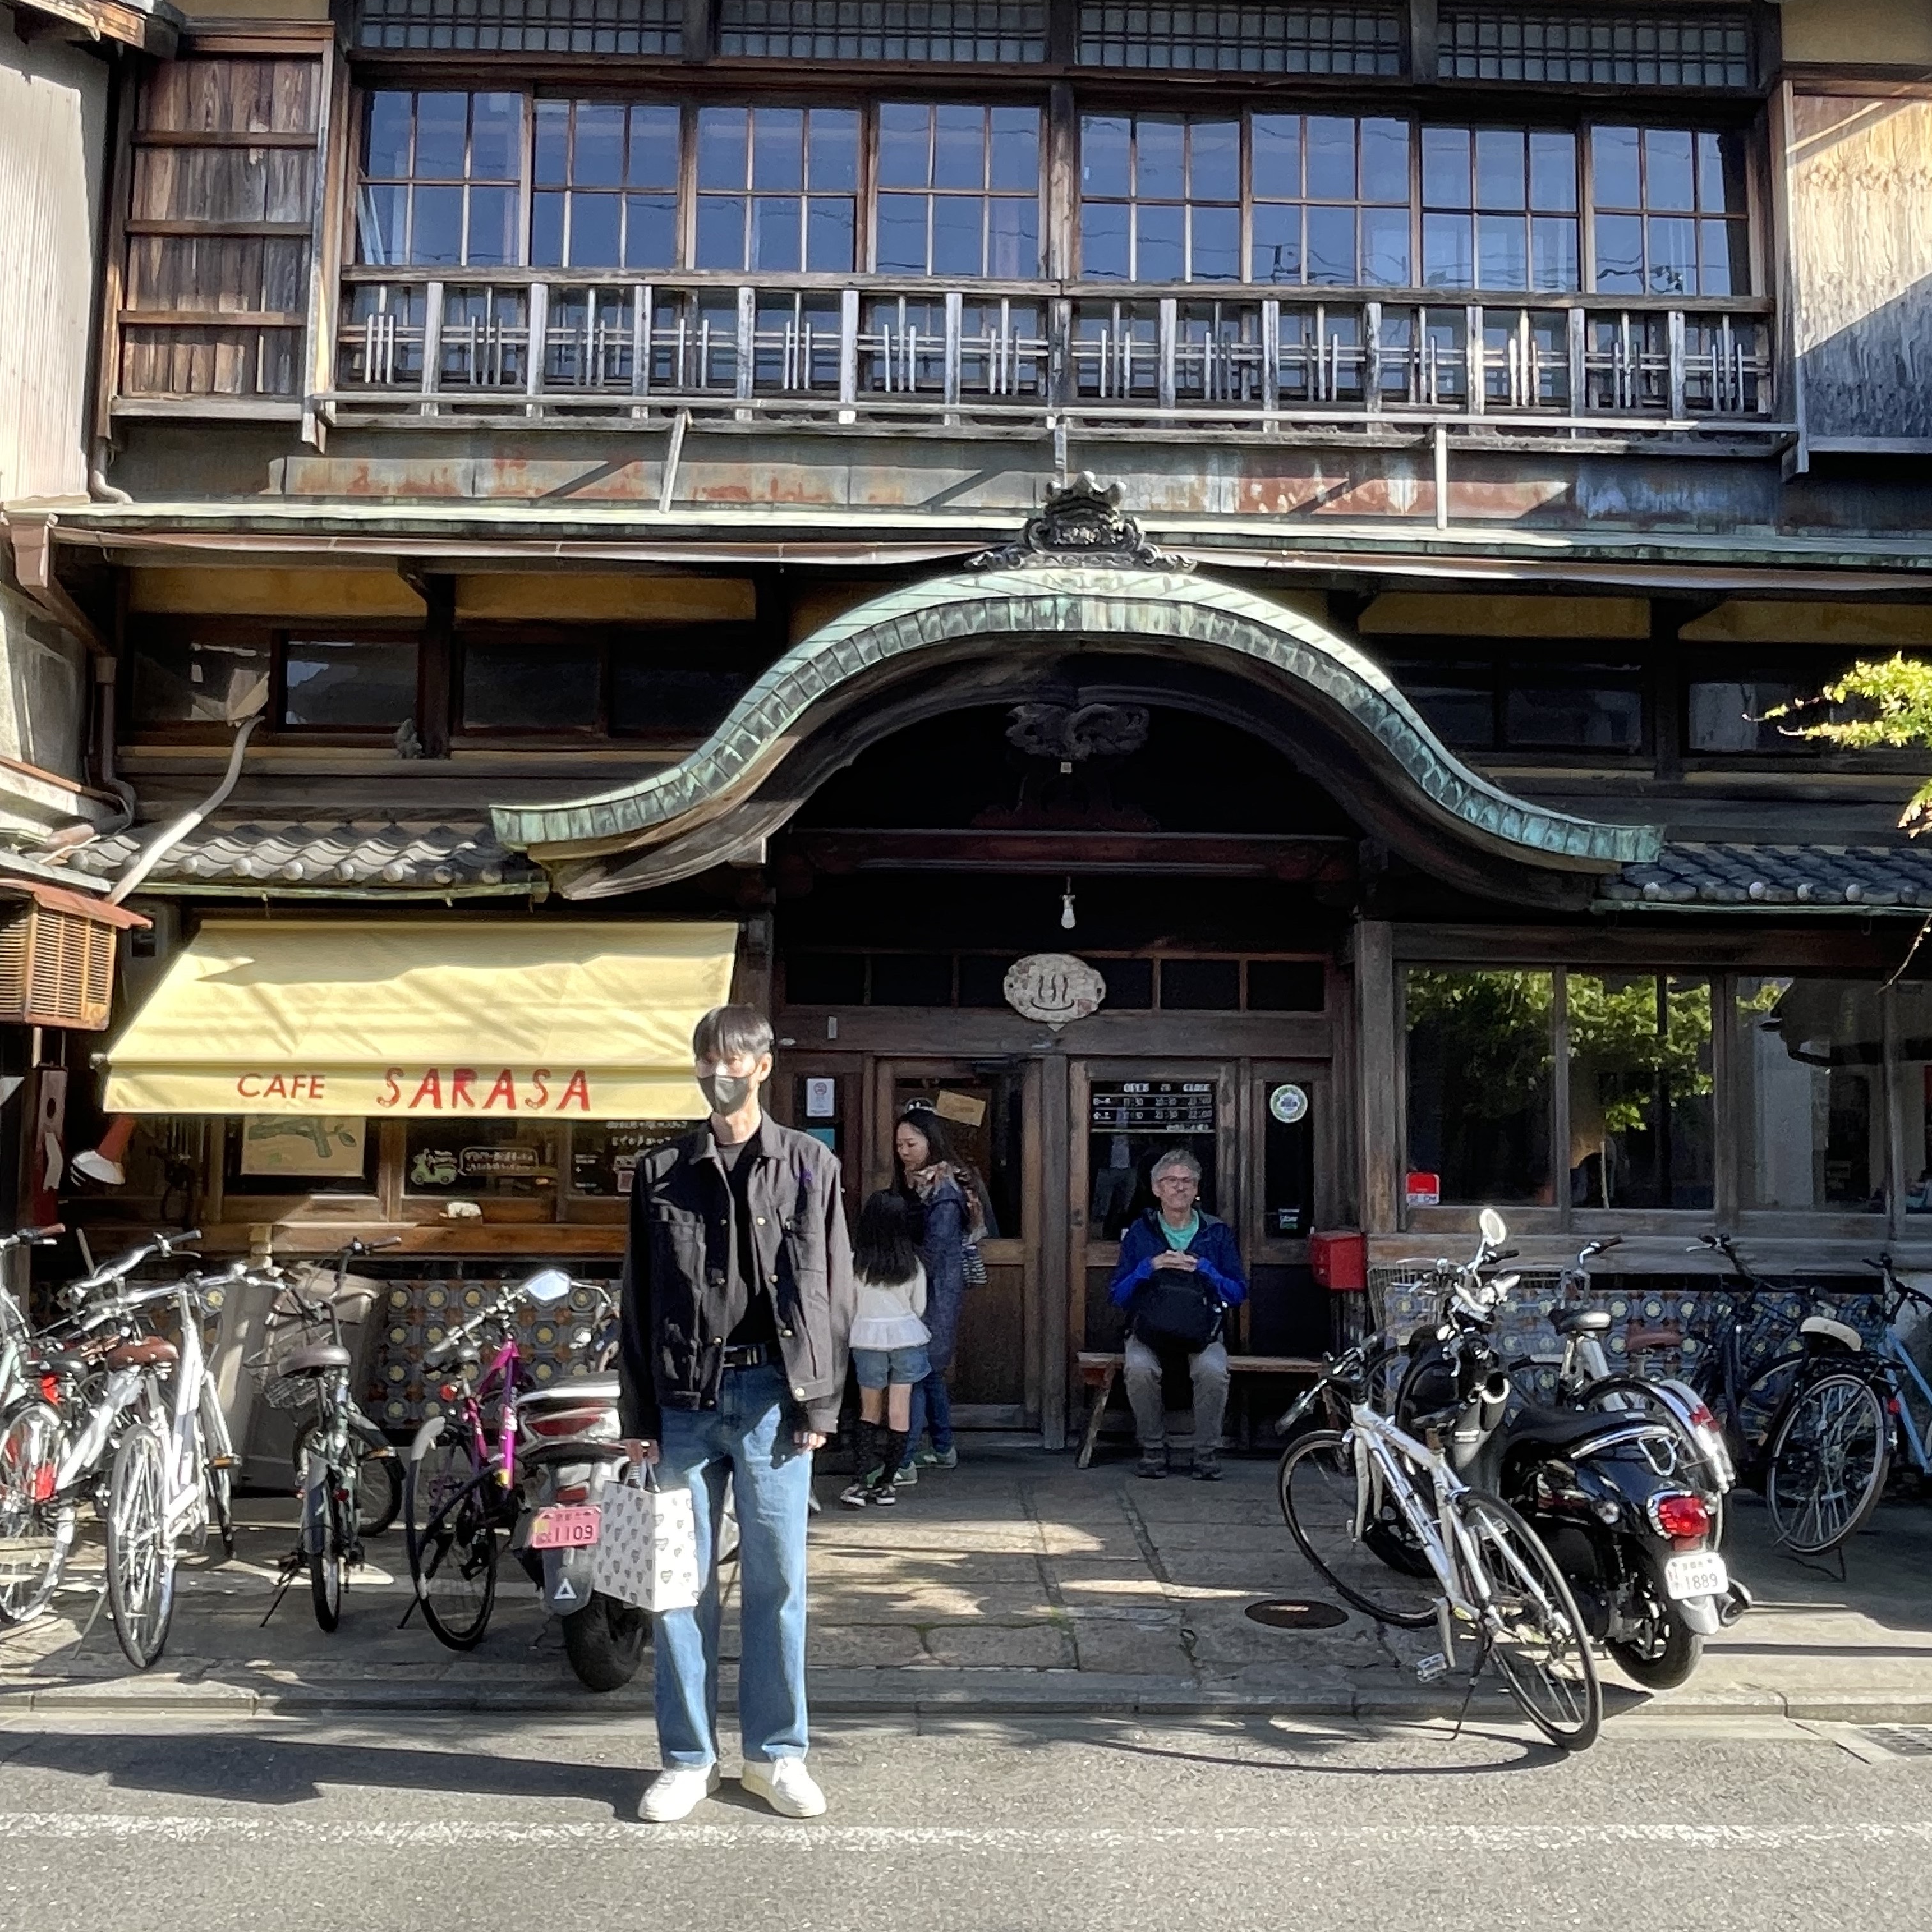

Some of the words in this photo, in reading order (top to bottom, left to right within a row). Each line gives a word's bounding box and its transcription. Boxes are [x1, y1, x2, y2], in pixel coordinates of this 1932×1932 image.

[236, 1073, 326, 1100] CAFE
[376, 1067, 590, 1111] SARASA
[555, 1524, 593, 1542] 1109
[1684, 1572, 1719, 1590] 1889
